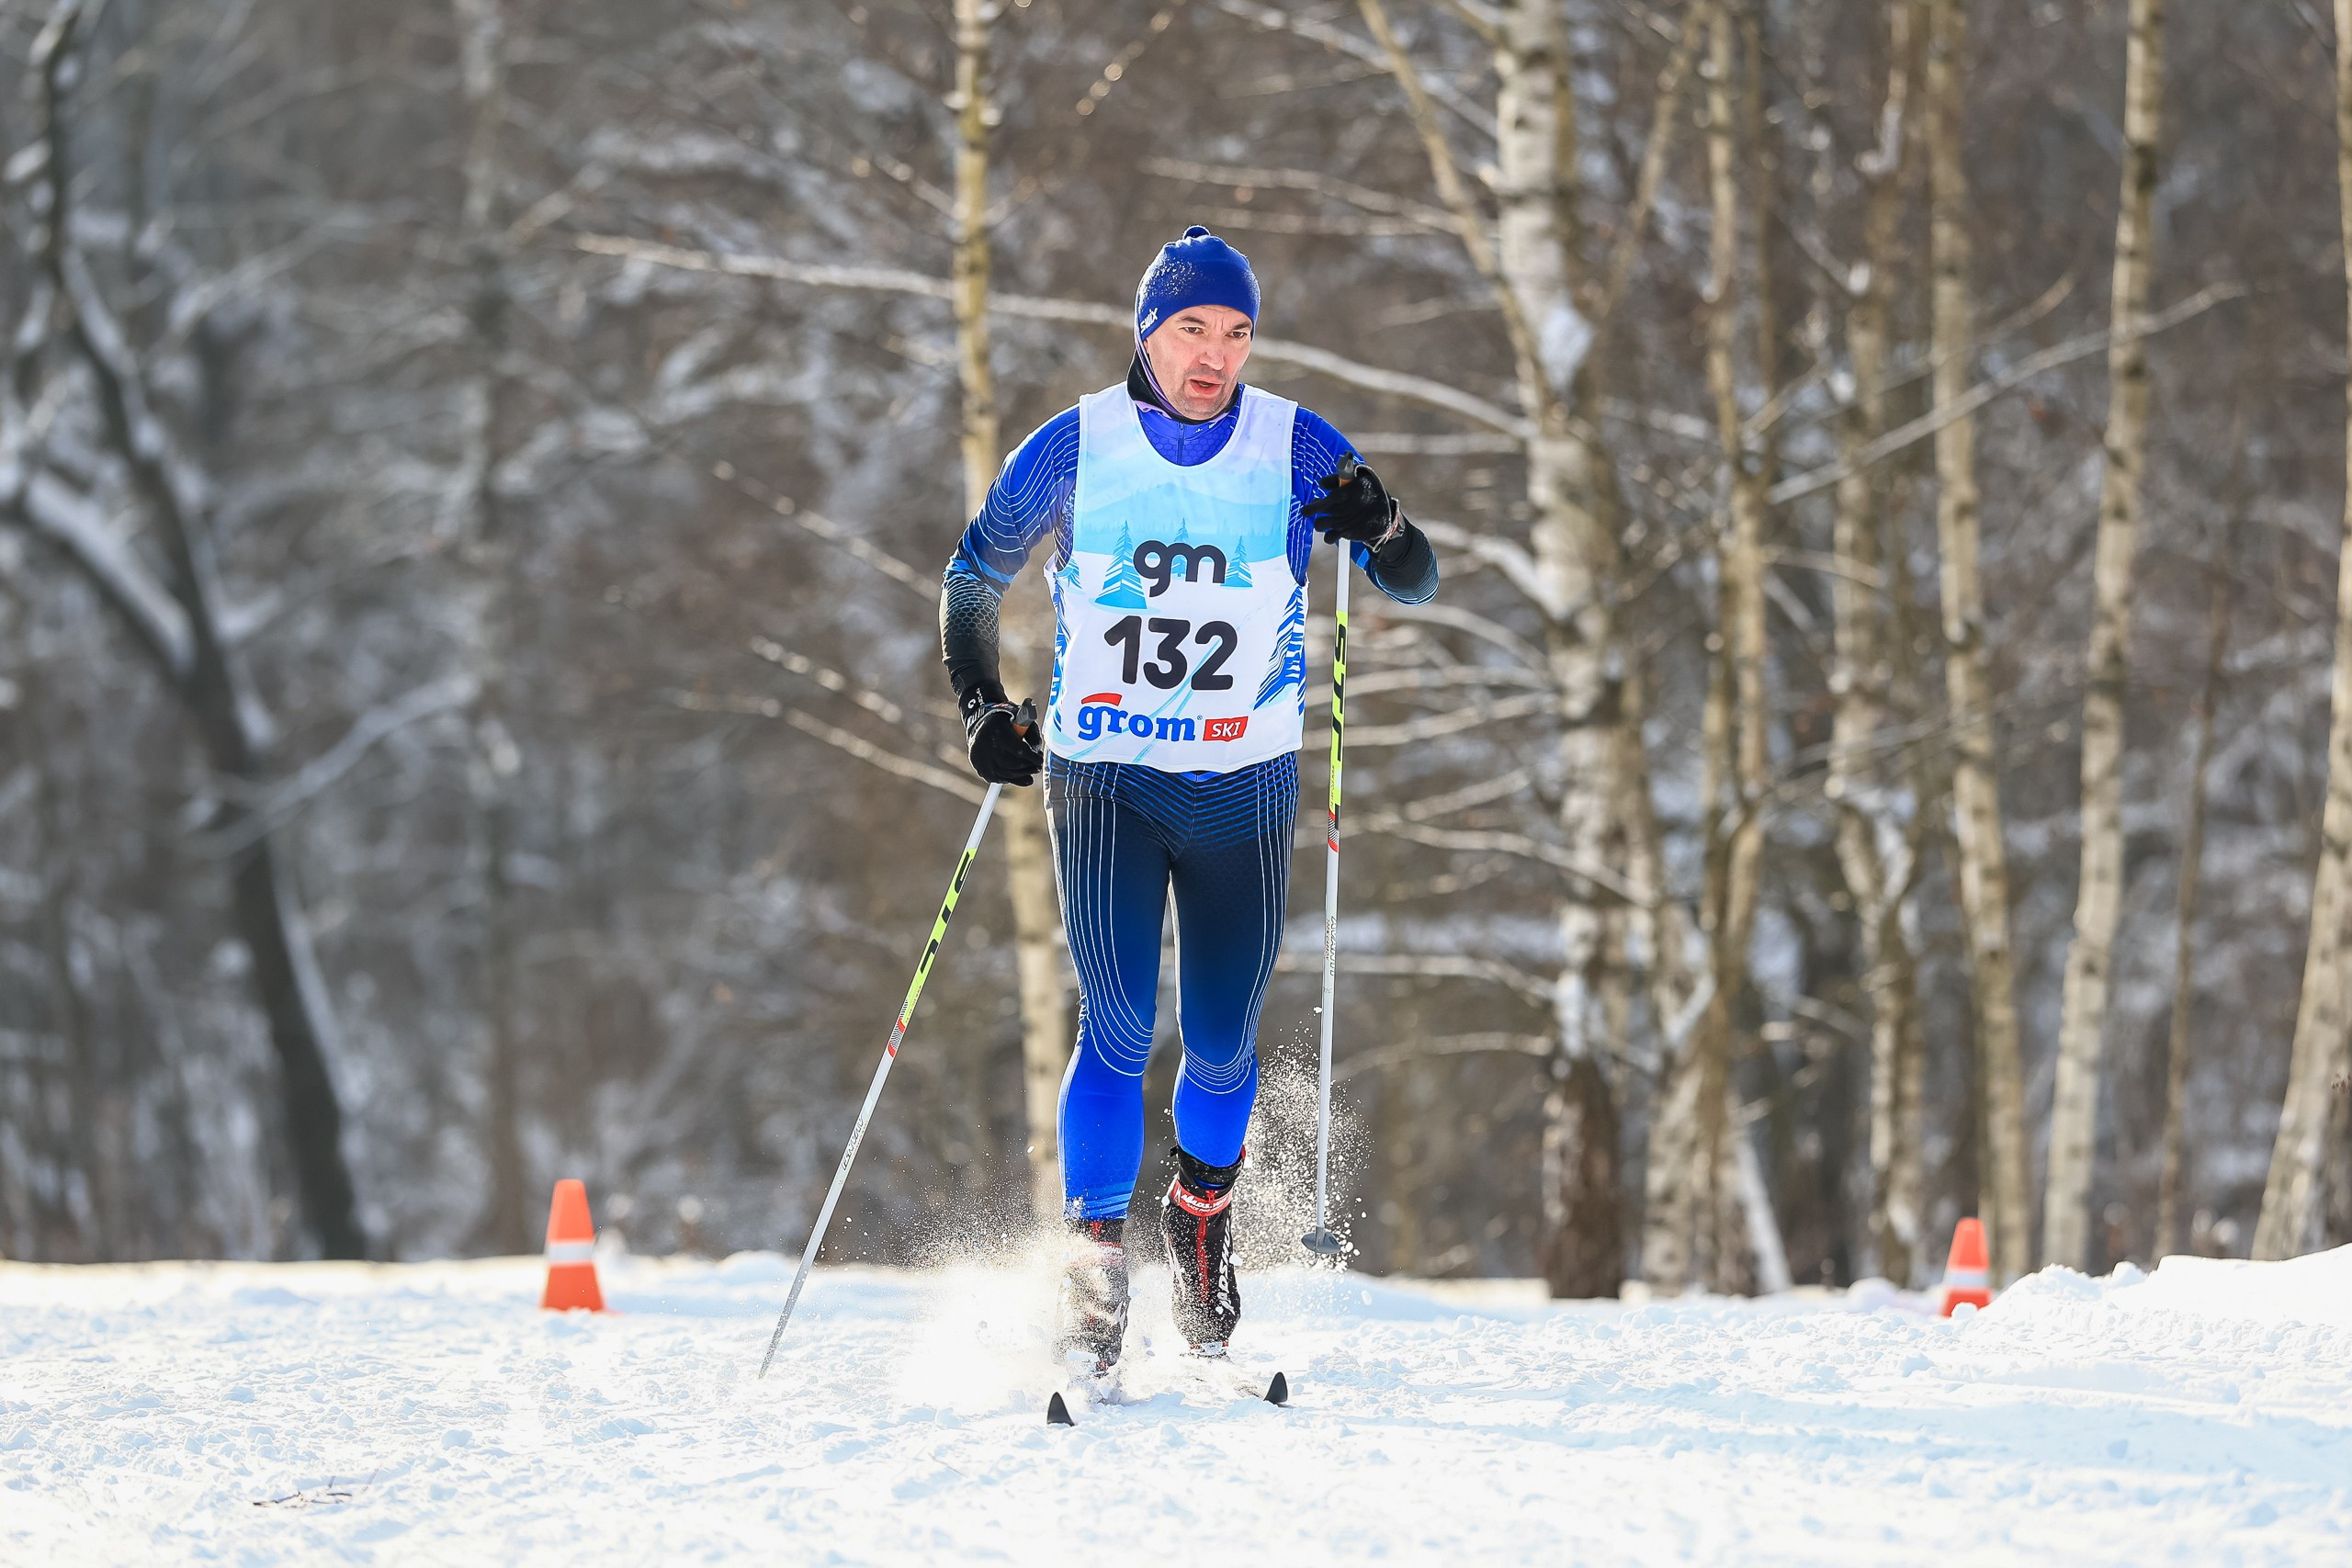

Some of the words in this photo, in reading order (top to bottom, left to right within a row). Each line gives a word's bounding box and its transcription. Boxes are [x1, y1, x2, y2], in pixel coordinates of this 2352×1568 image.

[1104, 615, 1238, 690] 132
[1078, 705, 1196, 741] grom
[1211, 721, 1241, 738] SKI
